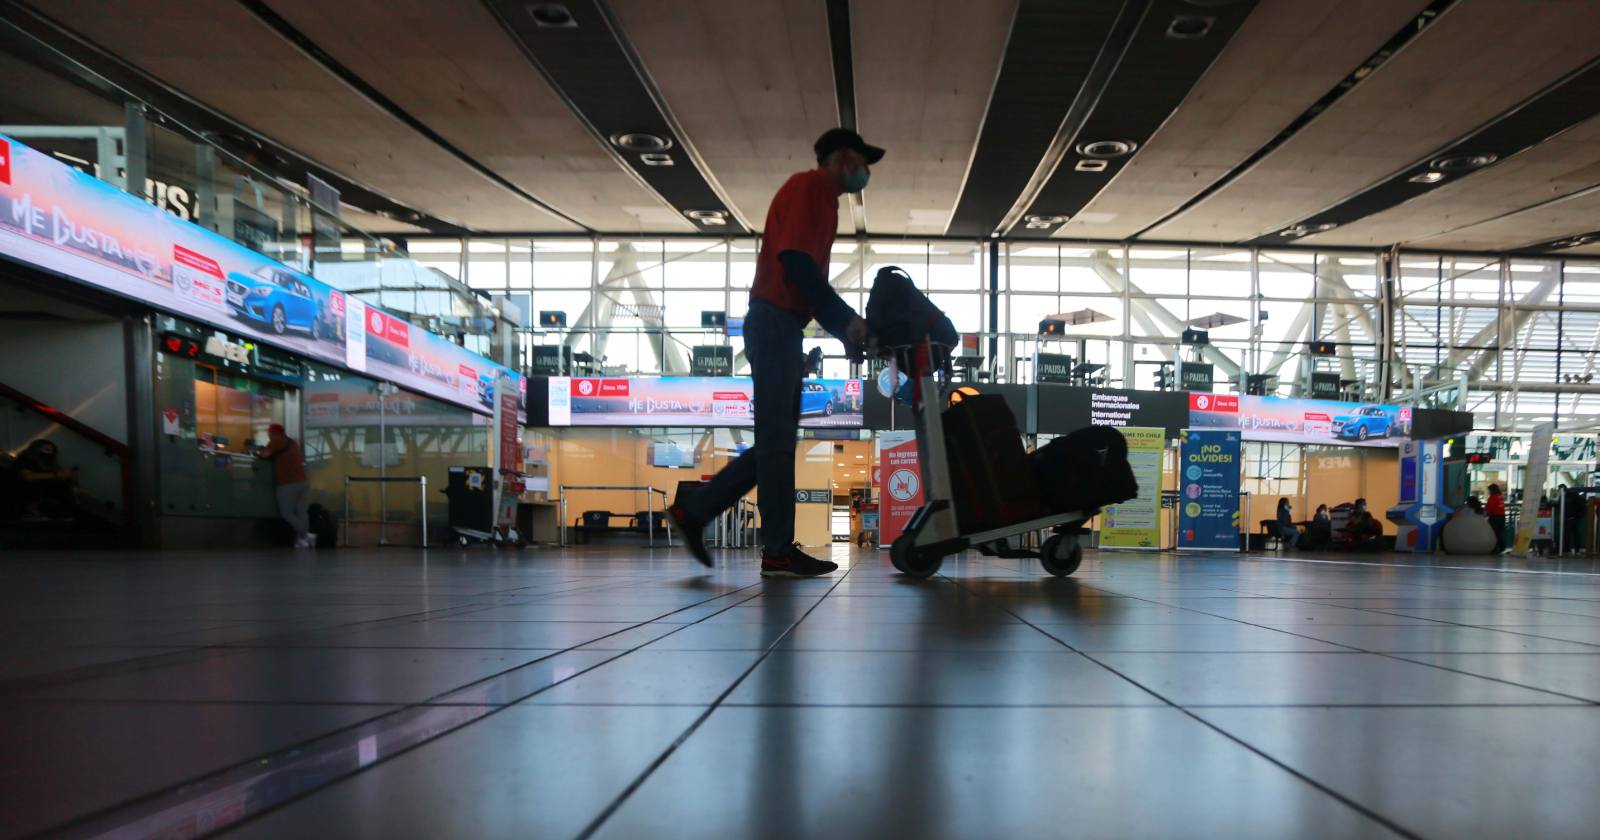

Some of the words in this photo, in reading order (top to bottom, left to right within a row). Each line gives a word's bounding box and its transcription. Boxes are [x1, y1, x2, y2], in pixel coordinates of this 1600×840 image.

[11, 193, 46, 234] ME
[52, 205, 124, 259] GUSTA
[1044, 363, 1066, 374] PAUSA
[1189, 372, 1209, 382] PAUSA
[1091, 393, 1129, 403] Embarques
[629, 397, 644, 414] ME
[647, 397, 682, 414] GUSTA
[1091, 401, 1140, 410] Internacionales
[1091, 410, 1131, 419] International
[1091, 417, 1127, 426] Departures
[1189, 454, 1233, 463] OLVIDES!
